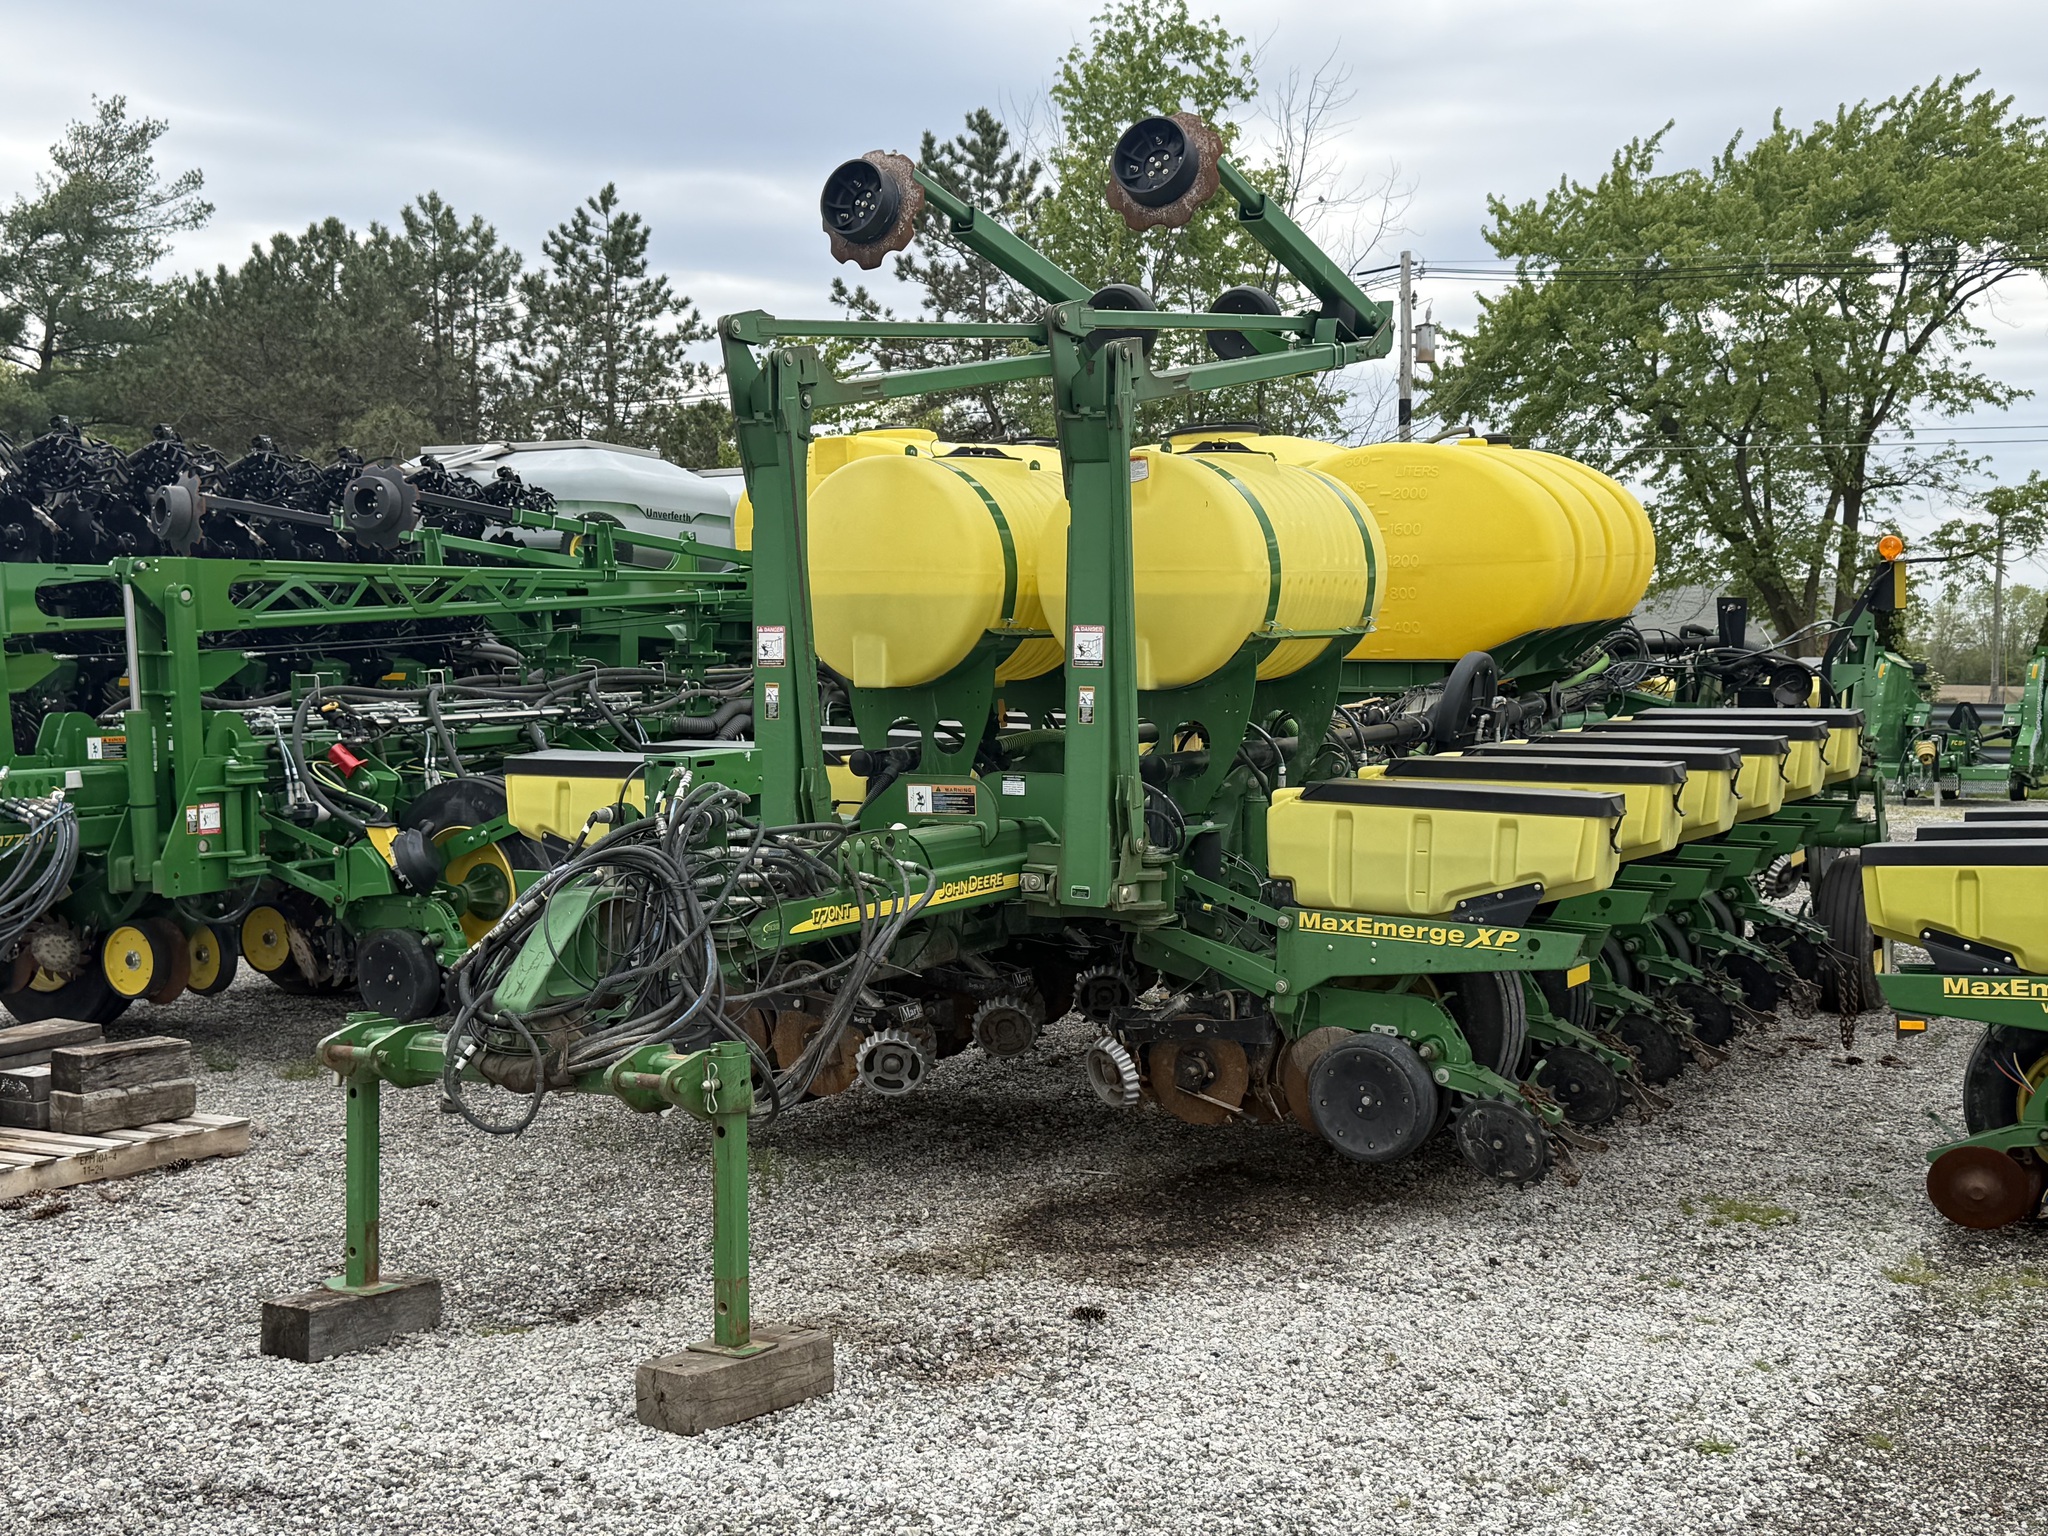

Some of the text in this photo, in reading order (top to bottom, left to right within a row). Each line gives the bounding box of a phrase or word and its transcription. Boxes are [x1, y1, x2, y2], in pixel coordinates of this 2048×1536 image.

[1395, 465, 1440, 477] LITERS
[1392, 487, 1428, 499] 2000
[646, 507, 691, 522] Unverferth
[1389, 523, 1422, 535] 1600
[1388, 554, 1420, 567] 1200
[1388, 586, 1417, 599] 800
[1392, 621, 1421, 633] 400
[939, 872, 1003, 898] JOHN DEERE
[811, 903, 851, 924] 1770NT
[1299, 912, 1521, 949] MaxEmerge XP
